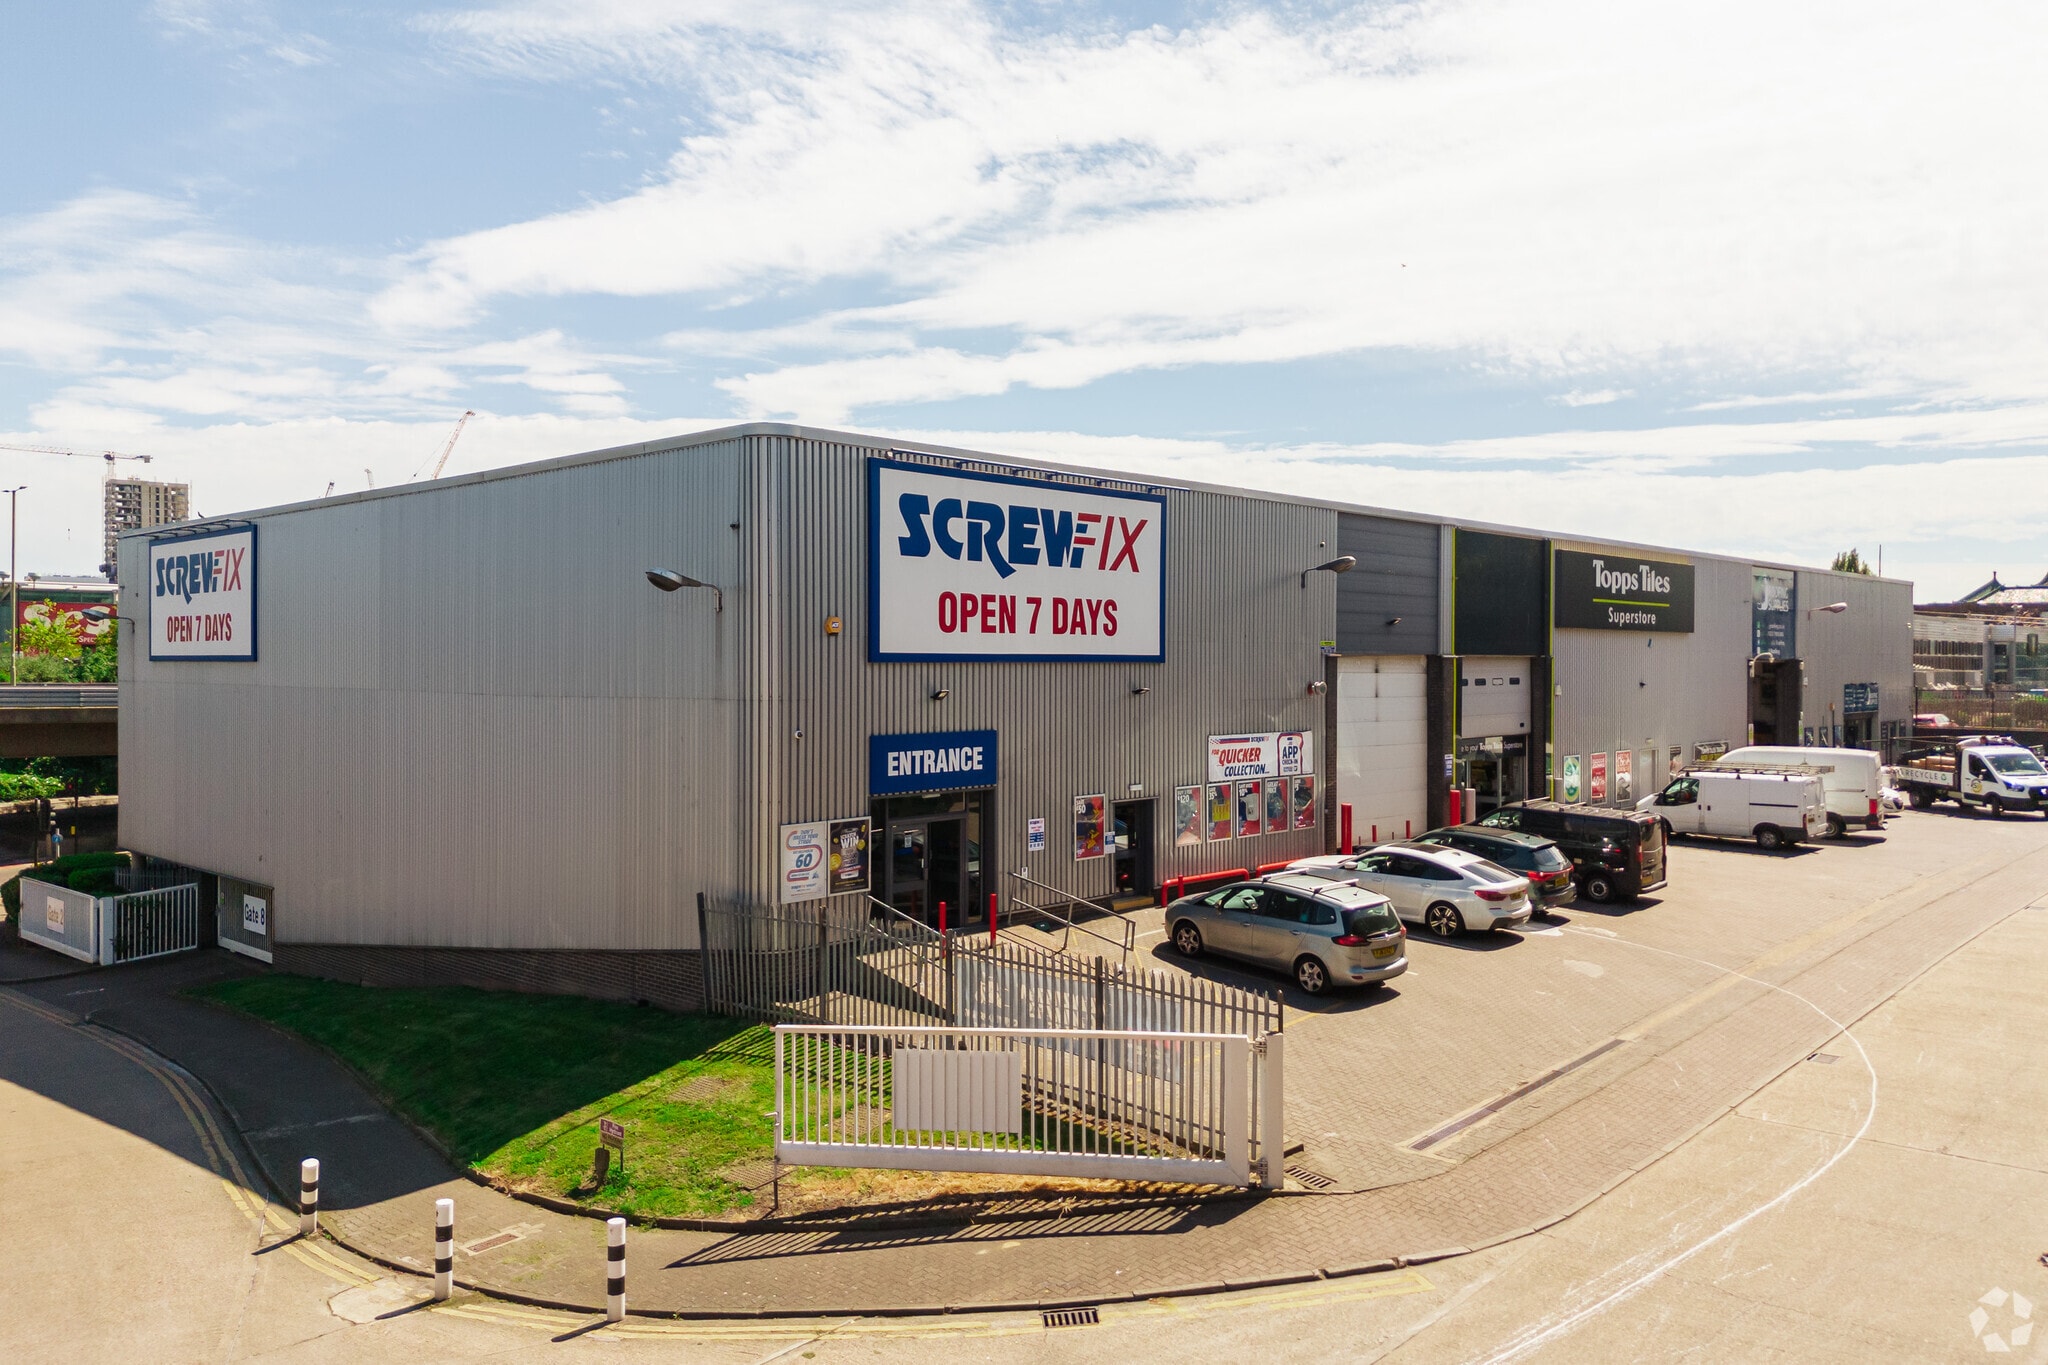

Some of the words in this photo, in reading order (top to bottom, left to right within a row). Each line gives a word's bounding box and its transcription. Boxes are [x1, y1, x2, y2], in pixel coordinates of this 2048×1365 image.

[898, 492, 1148, 579] SCREWFIX
[156, 547, 245, 605] SCREWFIX
[1592, 559, 1639, 595] Topps
[1639, 564, 1671, 593] Tiles
[938, 590, 1017, 634] OPEN
[1026, 596, 1042, 635] 7
[1052, 596, 1118, 637] DAYS
[1608, 606, 1656, 627] Superstore
[167, 615, 193, 642] OPEN
[195, 615, 202, 642] 7
[205, 612, 232, 641] DAYS
[887, 746, 983, 776] ENTRANCE
[1219, 747, 1261, 766] QUICKER
[1282, 746, 1298, 759] APP
[1905, 769, 1938, 780] RECYCLE
[841, 836, 859, 849] WIN
[795, 853, 813, 868] 60
[48, 904, 59, 923] Gate
[245, 903, 259, 924] Gate
[260, 907, 265, 925] 8
